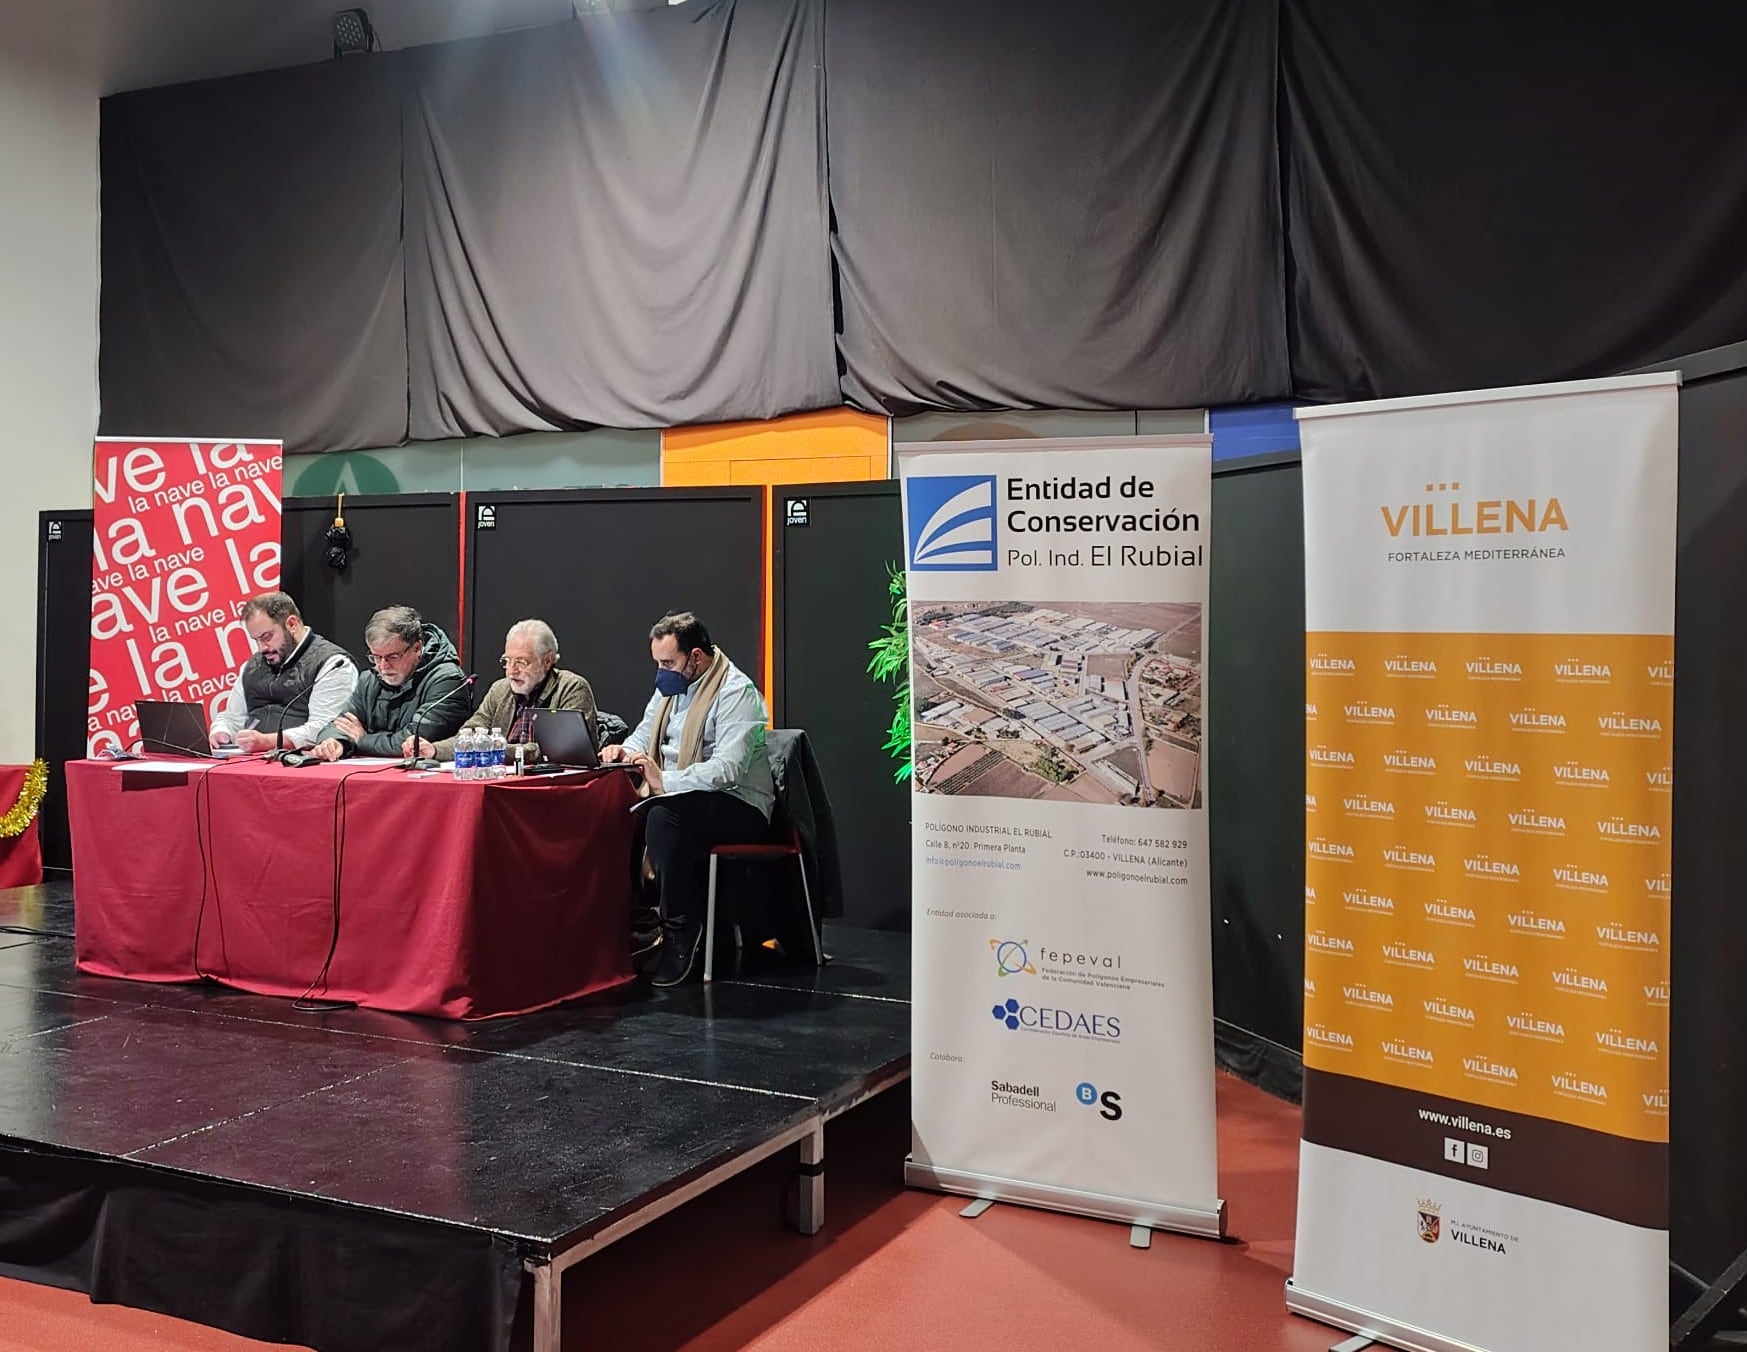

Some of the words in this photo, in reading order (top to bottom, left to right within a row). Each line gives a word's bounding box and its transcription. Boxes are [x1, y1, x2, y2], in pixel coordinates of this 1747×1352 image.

[128, 495, 150, 514] la
[154, 479, 205, 507] nave
[208, 470, 231, 489] la
[234, 455, 282, 482] nave
[1007, 476, 1111, 501] Entidad
[1119, 475, 1154, 498] de
[1007, 508, 1199, 533] Conservación
[1380, 497, 1569, 537] VILLENA
[1007, 549, 1042, 567] Pol.
[1049, 549, 1084, 567] Ind.
[1091, 545, 1111, 567] El
[1121, 545, 1202, 567] Rubial
[1388, 550, 1461, 563] FORTALEZA
[1464, 547, 1566, 562] MEDITERRÁNEA
[128, 564, 149, 582] la
[153, 546, 205, 573] nave
[149, 625, 171, 643] la
[175, 608, 226, 636] nave
[126, 638, 199, 696] la
[1310, 659, 1355, 669] VILLENA
[1385, 661, 1436, 671] VILLENA
[1466, 663, 1522, 673] VILLENA
[1555, 665, 1610, 676] VILLENA
[1345, 706, 1395, 718] VILLENA
[1426, 710, 1476, 721] VILLENA
[1510, 714, 1566, 726] VILLENA
[1599, 718, 1661, 730] VILLENA
[1309, 750, 1354, 762] VILLENA
[1384, 755, 1435, 768] VILLENA
[1465, 761, 1520, 774] VILLENA
[1554, 767, 1609, 780] VILLENA
[1344, 800, 1394, 812] VILLENA
[1425, 807, 1476, 820] VILLENA
[1509, 814, 1565, 828] VILLENA
[1597, 822, 1659, 836] VILLENA
[966, 824, 1011, 836] INDUSTRIAL
[1013, 827, 1023, 837] EL
[1024, 828, 1052, 839] RUBIAL
[925, 839, 941, 849] Calle
[973, 842, 1001, 852] Primera
[1003, 843, 1026, 854] Planta
[1101, 833, 1136, 846] Teléfono:
[1138, 838, 1152, 847] 647
[1155, 839, 1170, 848] 582
[1172, 839, 1188, 849] 929
[1307, 842, 1353, 856] VILLENA
[1112, 852, 1146, 865] VILLENA
[1147, 856, 1188, 868] (Alicante)
[1384, 851, 1435, 865] VILLENA
[1465, 860, 1519, 875] VILLENA
[1086, 869, 1188, 886] www.poligonoelrubial.com
[1554, 869, 1608, 885] VILLENA
[1344, 893, 1394, 908] VILLENA
[927, 907, 954, 918] Entidad
[1425, 904, 1475, 920] VILLENA
[1508, 915, 1565, 931] VILLENA
[1307, 933, 1353, 951] VILLENA
[1597, 927, 1658, 944] VILLENA
[1040, 947, 1121, 969] fepeval
[1383, 946, 1434, 963] VILLENA
[1464, 959, 1519, 976] VILLENA
[1553, 972, 1607, 991] VILLENA
[1344, 988, 1393, 1005] VILLENA
[1424, 1001, 1474, 1020] VILLENA
[1020, 1006, 1121, 1038] CEDAES
[1507, 1016, 1564, 1035] VILLENA
[1305, 1027, 1353, 1046] VILLENA
[1596, 1033, 1657, 1052] VILLENA
[1382, 1042, 1433, 1061] VILLENA
[1464, 1059, 1517, 1078] VILLENA
[991, 1080, 1039, 1097] Sabadell
[1552, 1076, 1607, 1097] VILLENA
[991, 1092, 1057, 1112] Professional
[1418, 1109, 1512, 1140] www.villena.es
[1461, 1222, 1509, 1240] AYUNTAMIENTO
[1450, 1228, 1506, 1255] VILLENA
